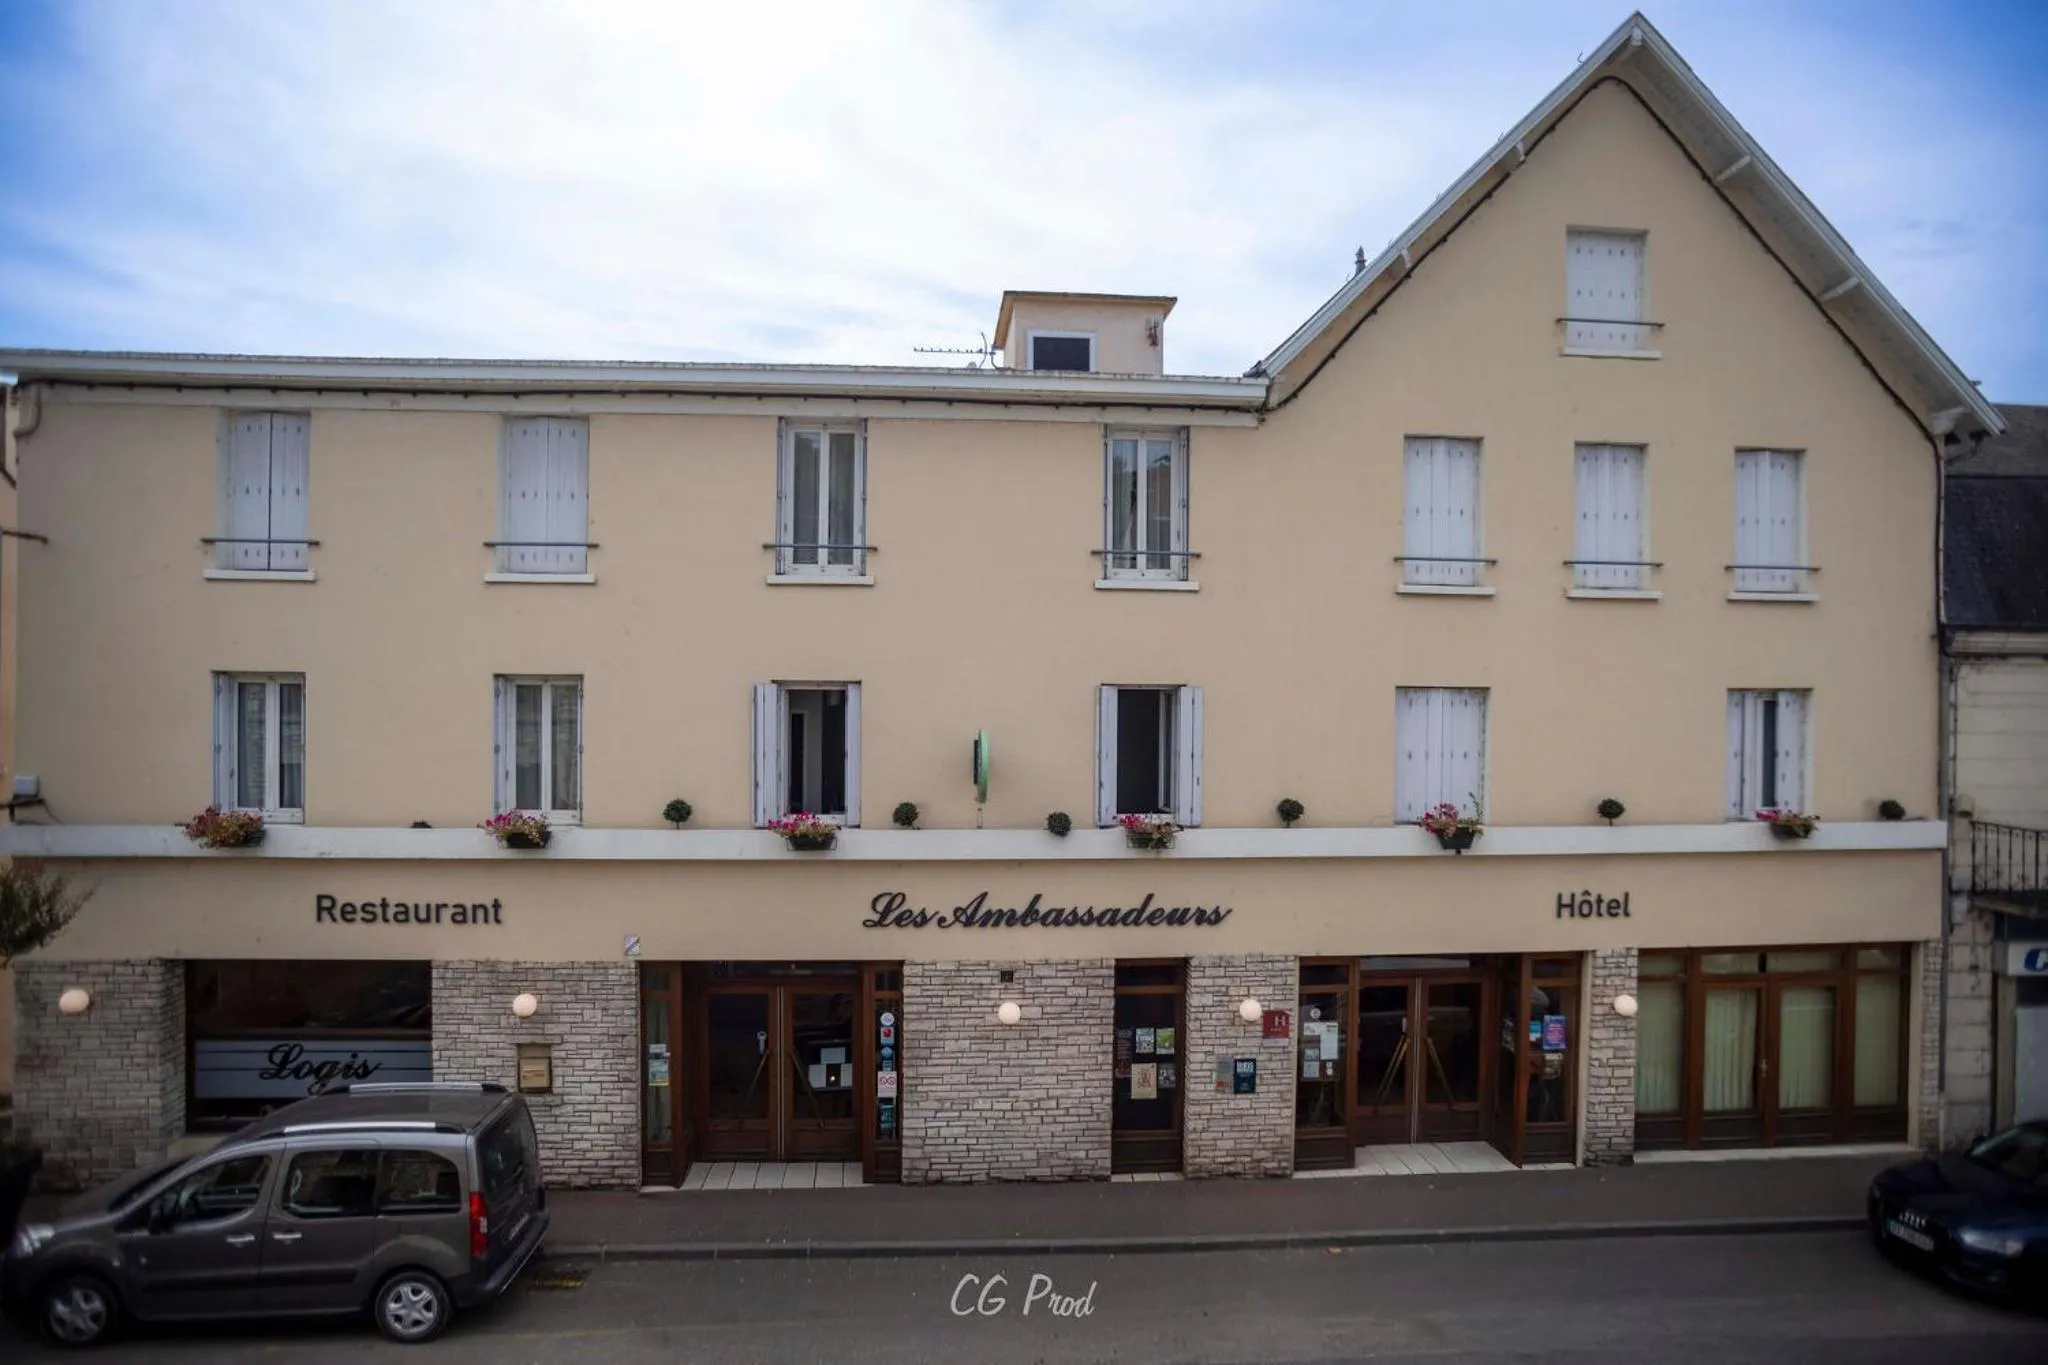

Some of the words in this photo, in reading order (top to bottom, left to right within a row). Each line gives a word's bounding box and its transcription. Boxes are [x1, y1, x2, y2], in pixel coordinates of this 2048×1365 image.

[316, 894, 502, 925] Restaurant
[862, 892, 940, 928] Les
[938, 892, 1233, 928] Ambassadeurs
[1556, 889, 1631, 919] Hôtel
[1274, 1015, 1286, 1027] H
[259, 1044, 383, 1096] Logis
